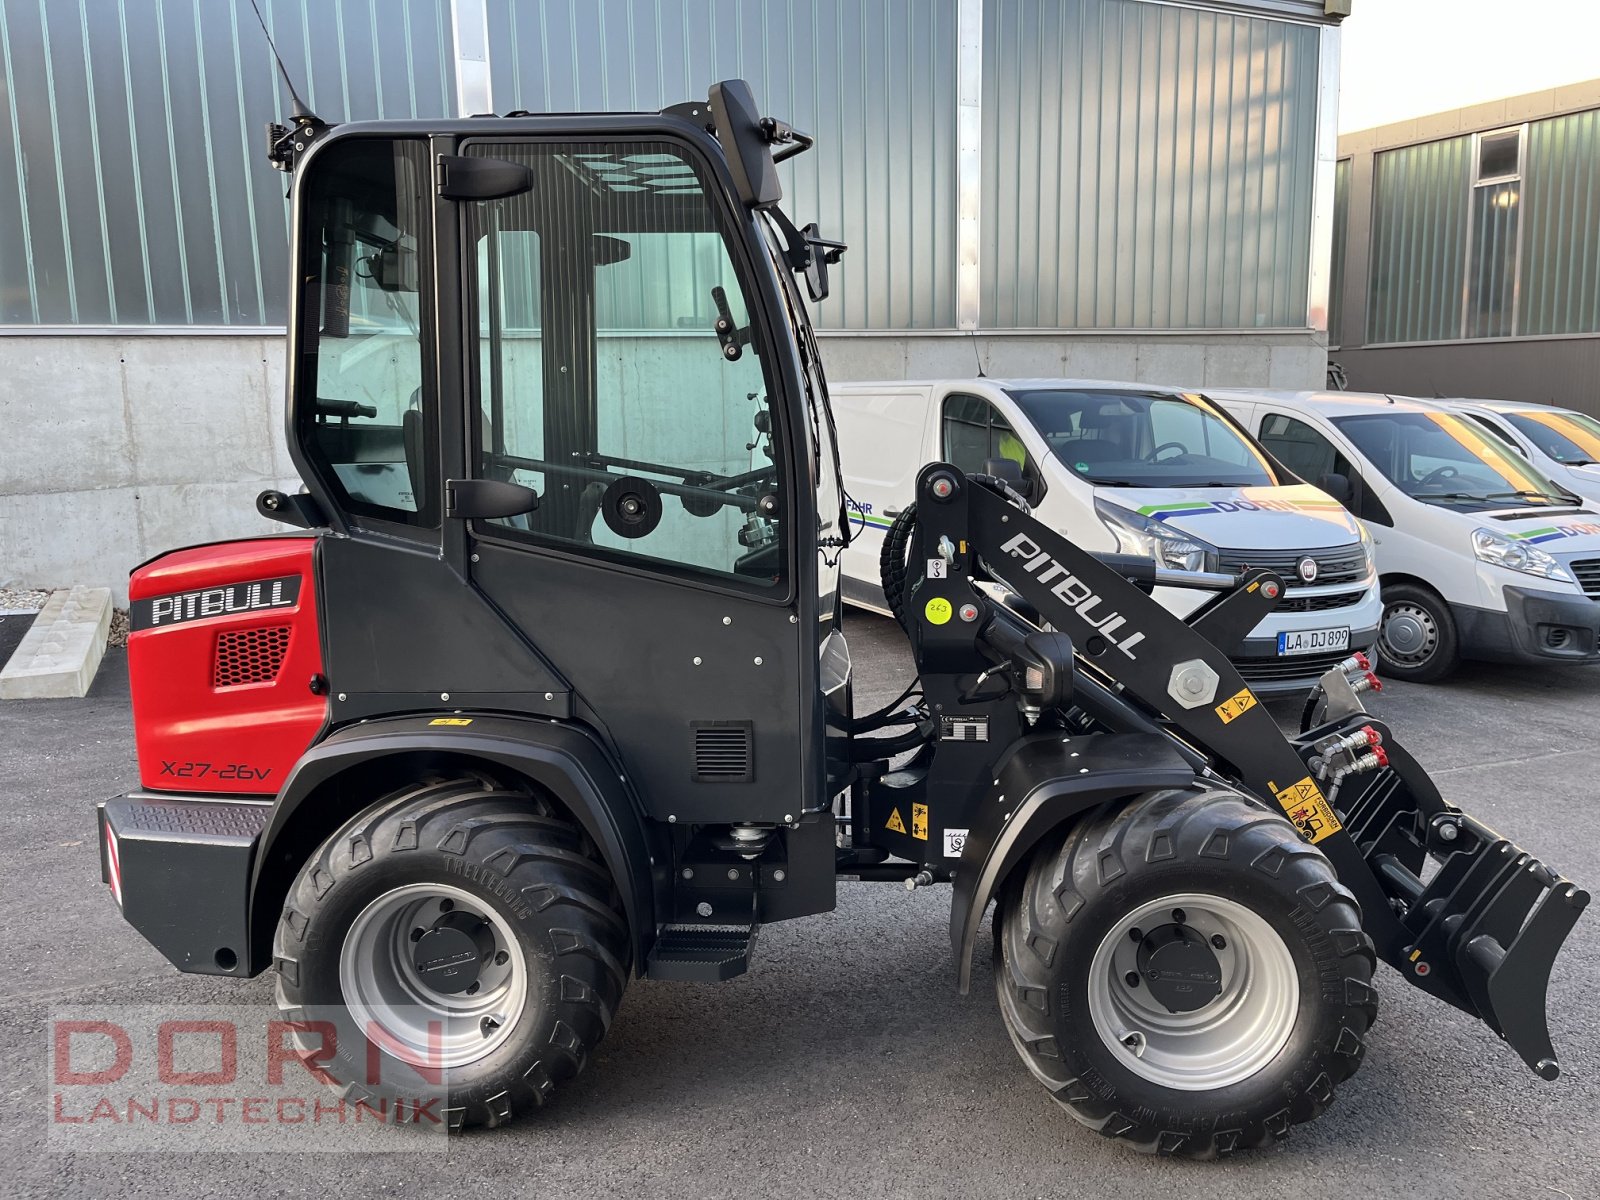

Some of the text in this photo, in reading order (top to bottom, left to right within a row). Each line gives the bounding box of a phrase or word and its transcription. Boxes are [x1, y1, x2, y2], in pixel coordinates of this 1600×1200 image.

[846, 499, 873, 515] FAHR
[152, 581, 292, 625] PITBULL
[1000, 532, 1146, 661] PITBULL
[1286, 634, 1302, 650] LA
[1311, 632, 1326, 648] DJ
[1328, 629, 1348, 646] 899
[1316, 796, 1340, 829] FORBIDDEN
